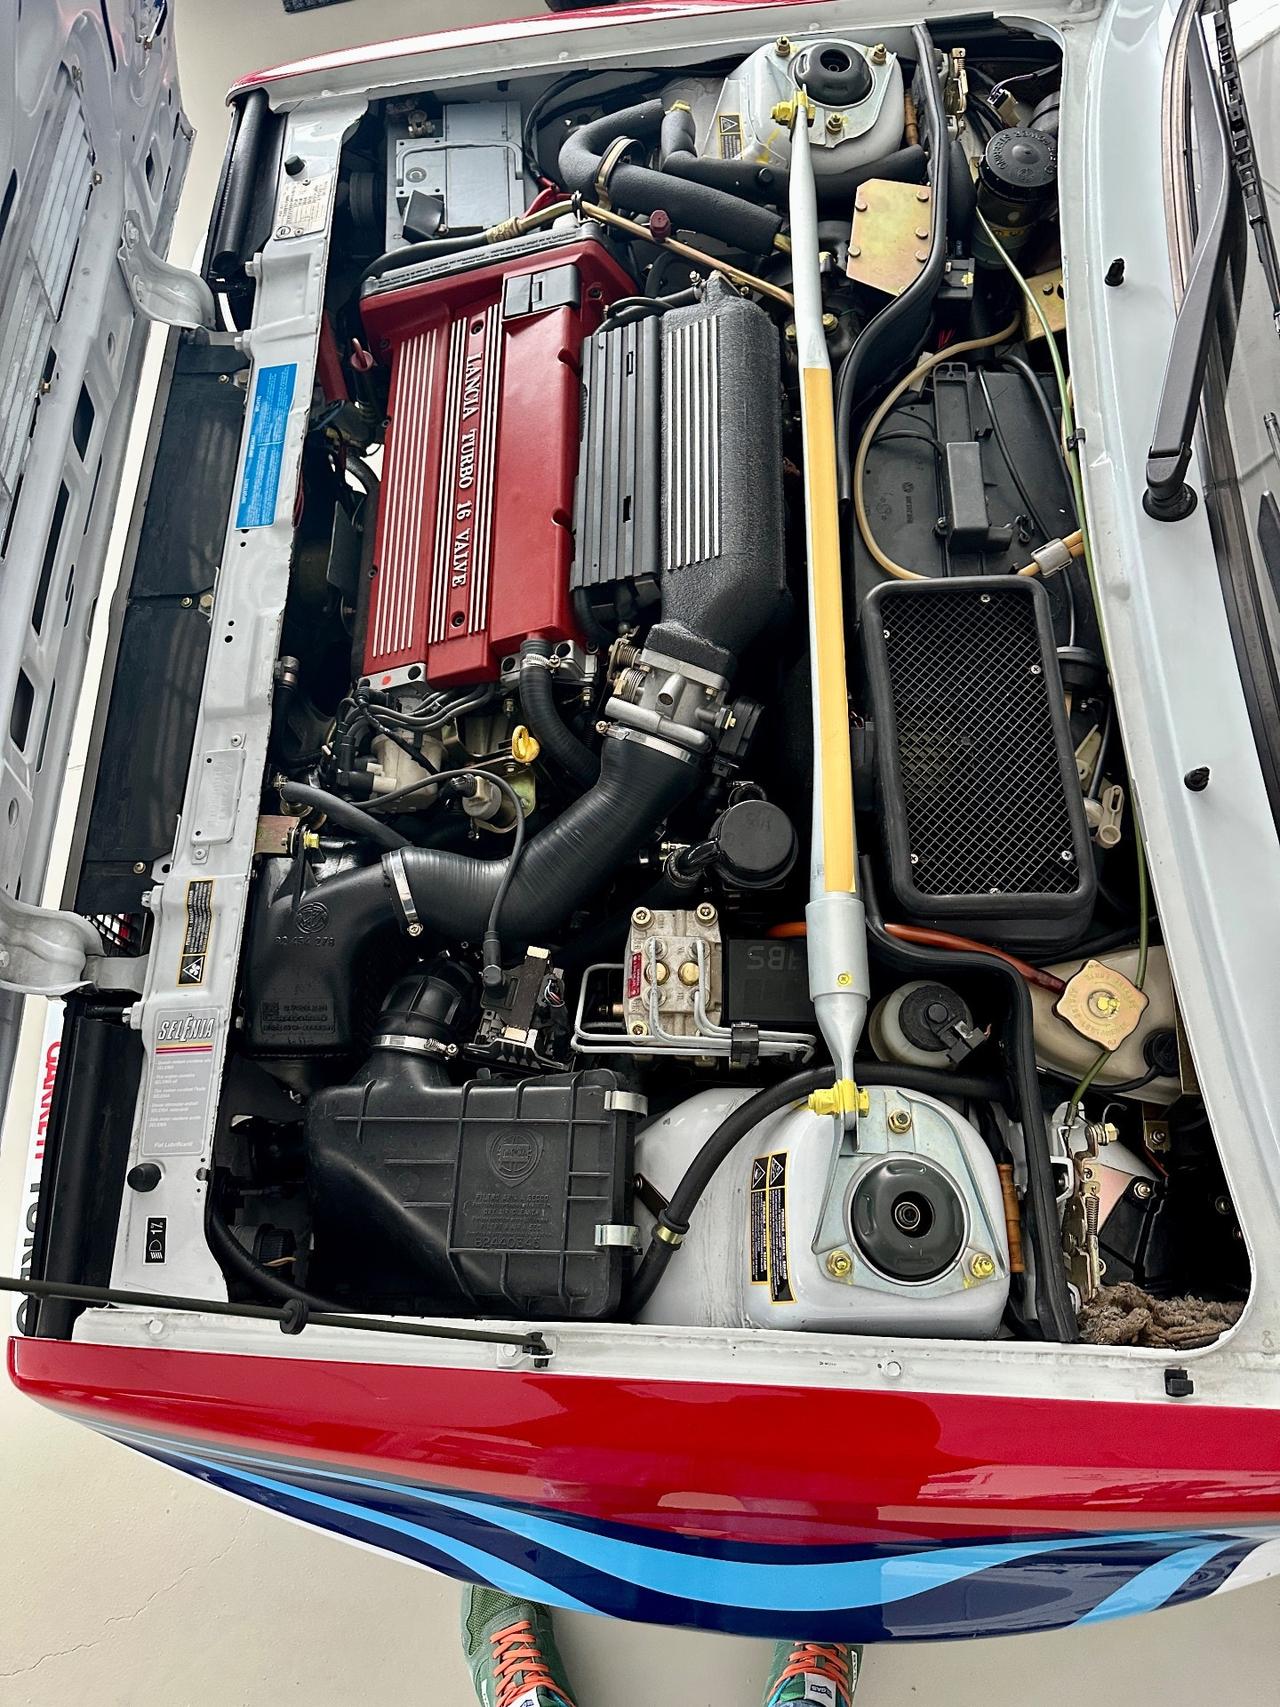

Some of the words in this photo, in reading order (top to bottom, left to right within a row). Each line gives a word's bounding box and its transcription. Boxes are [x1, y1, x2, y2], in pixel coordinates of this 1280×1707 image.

[463, 352, 483, 421] LANCIA
[458, 428, 478, 490] TURBO
[456, 500, 472, 521] 16
[452, 528, 471, 589] VALVE
